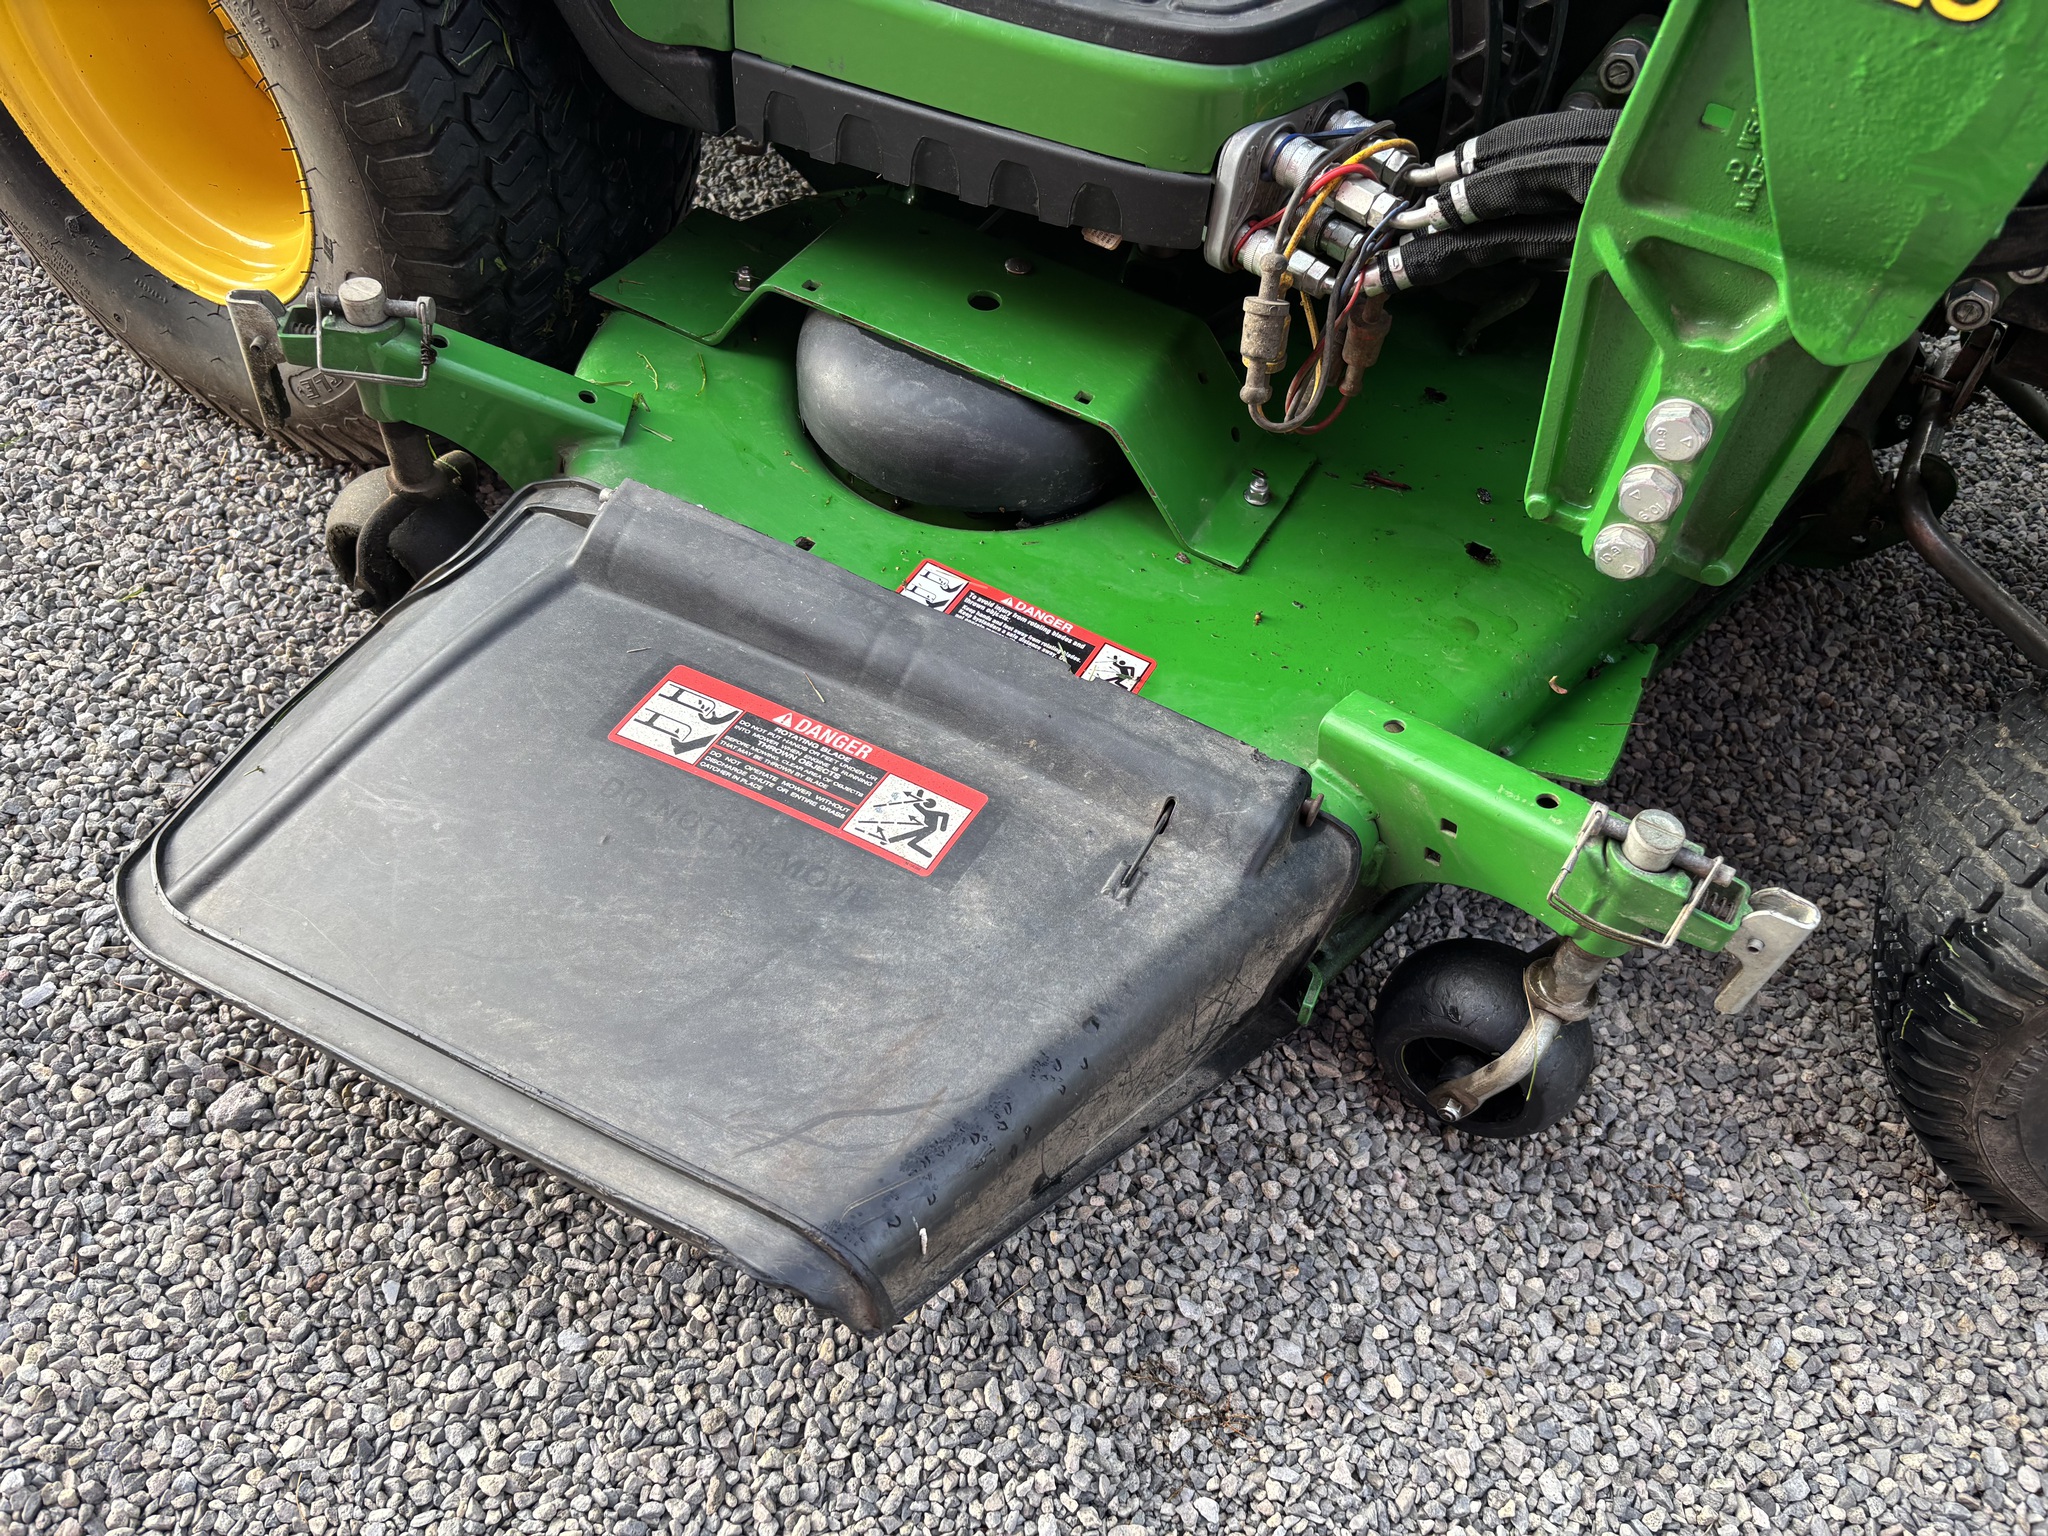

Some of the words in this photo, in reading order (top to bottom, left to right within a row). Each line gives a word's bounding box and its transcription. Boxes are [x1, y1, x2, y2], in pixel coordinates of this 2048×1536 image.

[1014, 601, 1073, 633] DANGER
[734, 725, 751, 734] INTO
[752, 732, 779, 746] MOWER
[781, 744, 803, 756] WHEN
[803, 754, 831, 768] ENGINE
[840, 770, 873, 787] RUNNING
[750, 725, 767, 734] NOT
[767, 732, 782, 740] PUT
[782, 738, 808, 751] HANDS
[808, 749, 821, 757] OR
[820, 754, 839, 764] FEET
[839, 762, 866, 776] UNDER
[757, 740, 798, 761] THROWN
[798, 758, 841, 779] OBJECTS
[774, 727, 819, 749] ROTATING
[820, 746, 852, 763] BLADE
[793, 718, 873, 759] DANGER
[700, 761, 732, 777] CATCHER
[739, 778, 763, 791] PLACE
[704, 755, 748, 776] DISCHARGE
[749, 774, 775, 788] CHUTE
[776, 786, 789, 794] OR
[790, 792, 818, 807] ENTIRE
[819, 805, 846, 819] GRASS
[709, 750, 722, 758] DO
[724, 756, 742, 766] NOT
[744, 765, 779, 782] OPERATE
[781, 780, 812, 797] MOWER
[815, 795, 850, 813] WITHOUT
[720, 740, 738, 750] THAT
[737, 747, 753, 756] MAY
[764, 758, 795, 774] THROWN
[805, 776, 829, 789] BLADE
[724, 735, 751, 748] BEFORE
[781, 759, 804, 771] CLEAR
[803, 769, 822, 779] AREA
[833, 781, 864, 797] OBJECTS
